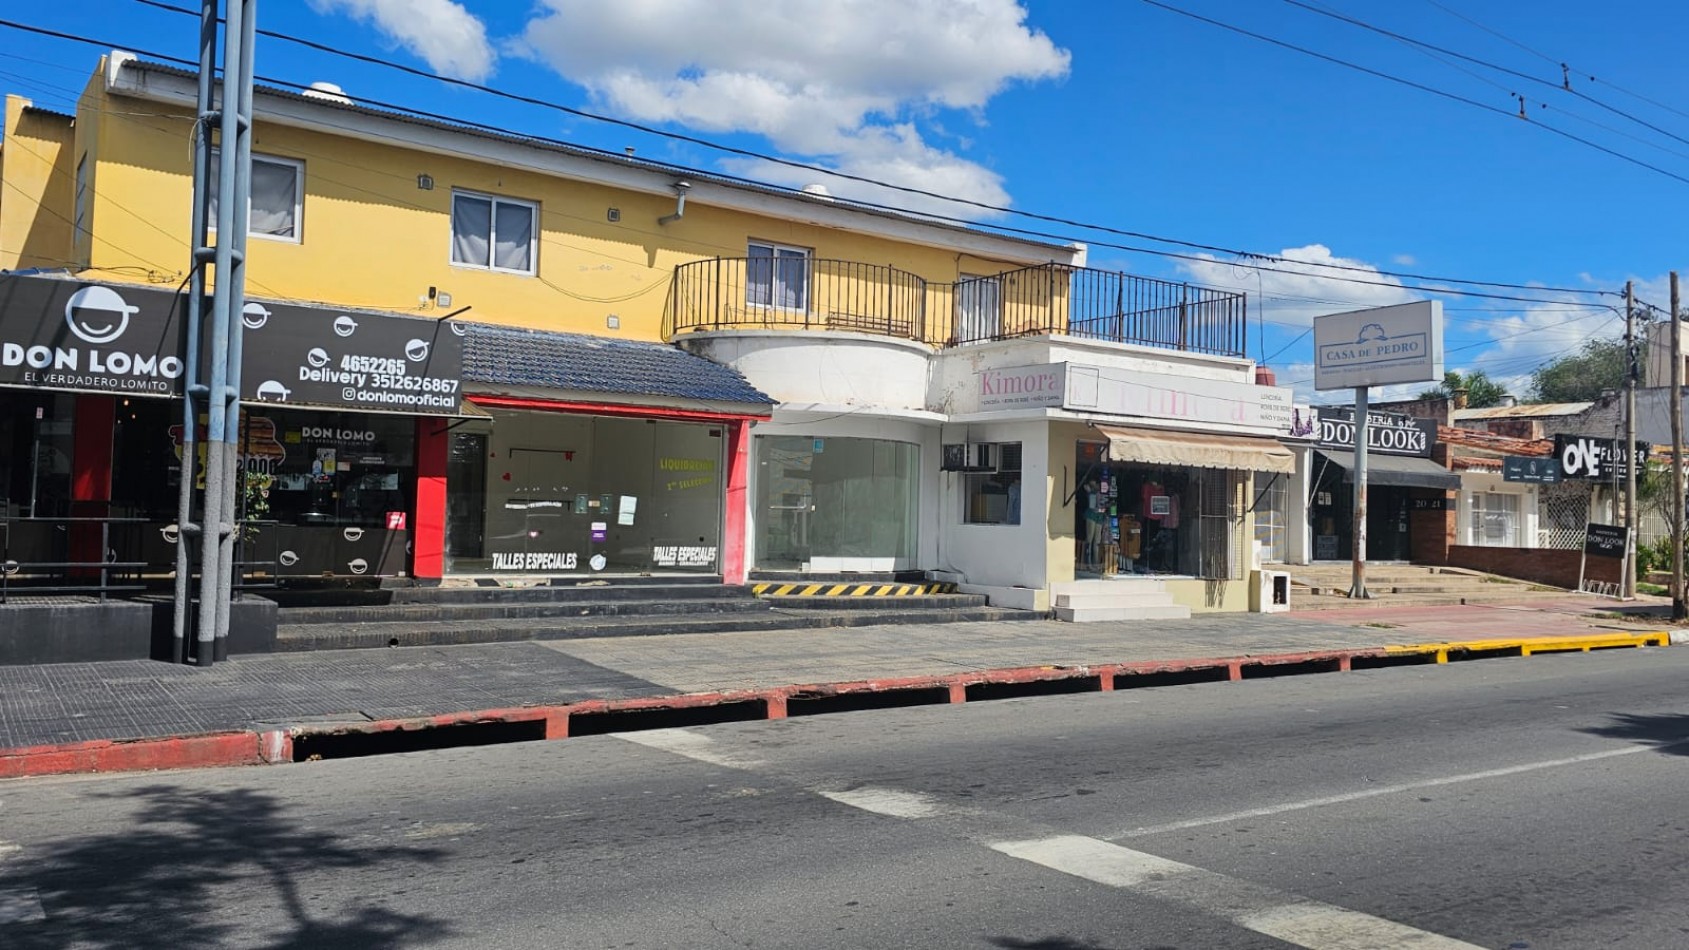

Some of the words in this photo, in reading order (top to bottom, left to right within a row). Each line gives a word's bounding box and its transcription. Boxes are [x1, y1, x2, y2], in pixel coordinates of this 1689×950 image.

[2, 342, 78, 371] DON
[89, 349, 184, 379] LOMO
[1326, 349, 1356, 361] CASA
[1358, 348, 1373, 358] DE
[1376, 341, 1419, 356] PEDRO
[340, 355, 406, 376] 4652265
[24, 371, 39, 382] EL
[42, 373, 118, 387] VERDADERO
[120, 379, 168, 391] LOMITO
[299, 366, 366, 388] Delivery
[371, 373, 459, 393] 3512626867
[981, 371, 1060, 396] Kimora
[357, 389, 455, 408] donlomooficial
[302, 426, 332, 438] DON
[336, 428, 376, 441] LOMO
[1368, 426, 1420, 450] LOOK
[1562, 438, 1600, 477] ONE
[492, 552, 525, 570] TALLES
[525, 552, 578, 570] ESPECIALES
[653, 546, 678, 562] TALLES
[677, 546, 717, 562] ESPECIALES
